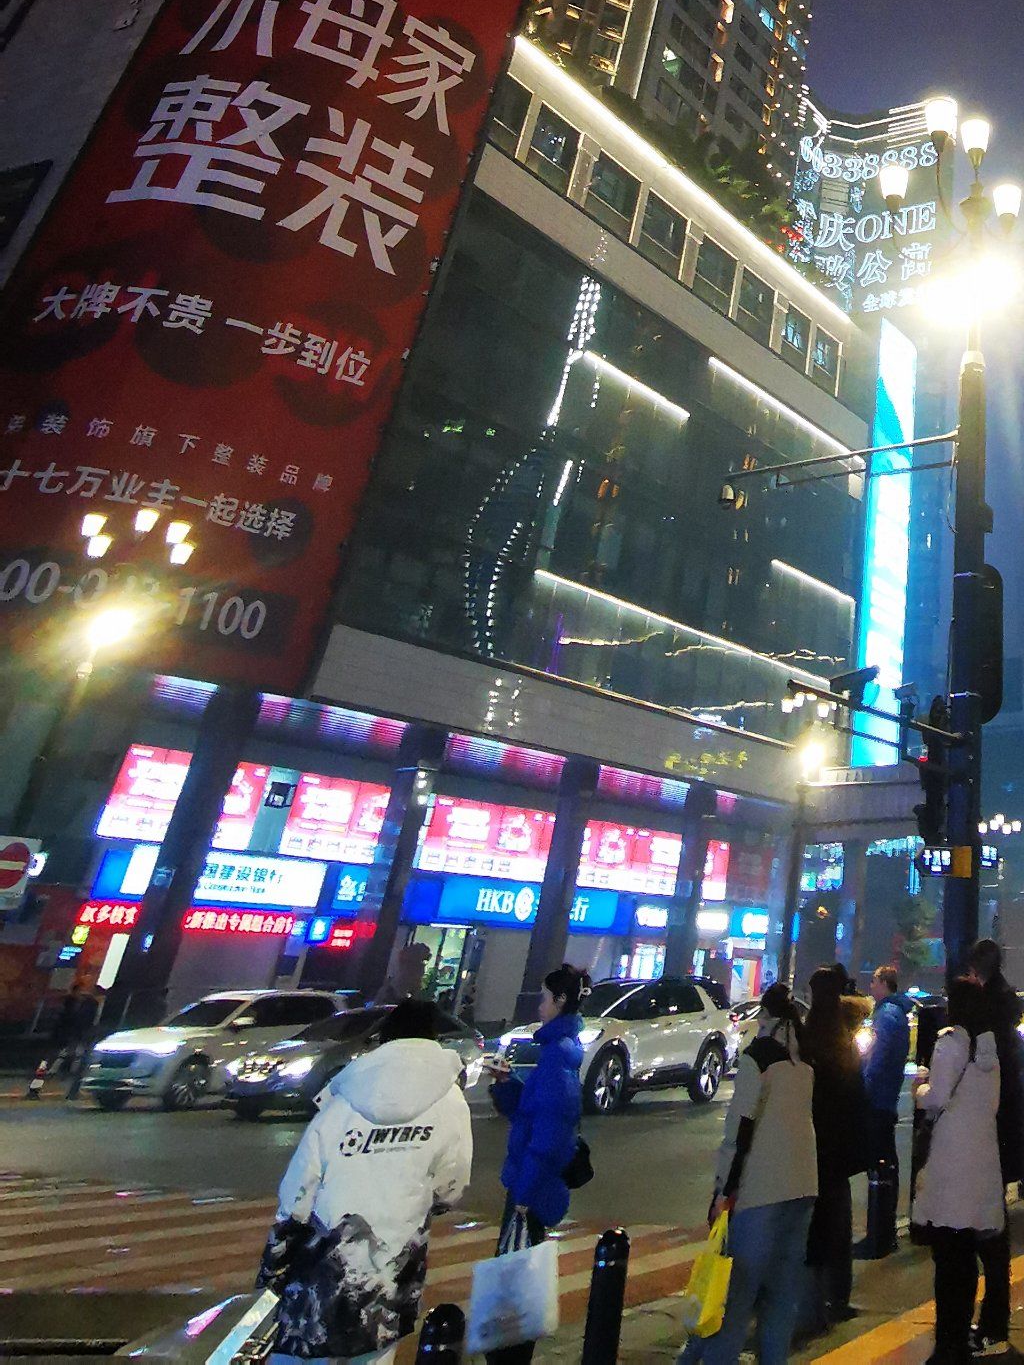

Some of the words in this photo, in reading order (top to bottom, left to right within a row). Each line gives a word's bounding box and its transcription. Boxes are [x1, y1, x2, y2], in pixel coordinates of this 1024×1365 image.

[105, 73, 435, 275] 整装
[33, 281, 214, 334] 大牌不贵
[225, 316, 372, 386] 一步到位
[475, 887, 516, 914] HKB
